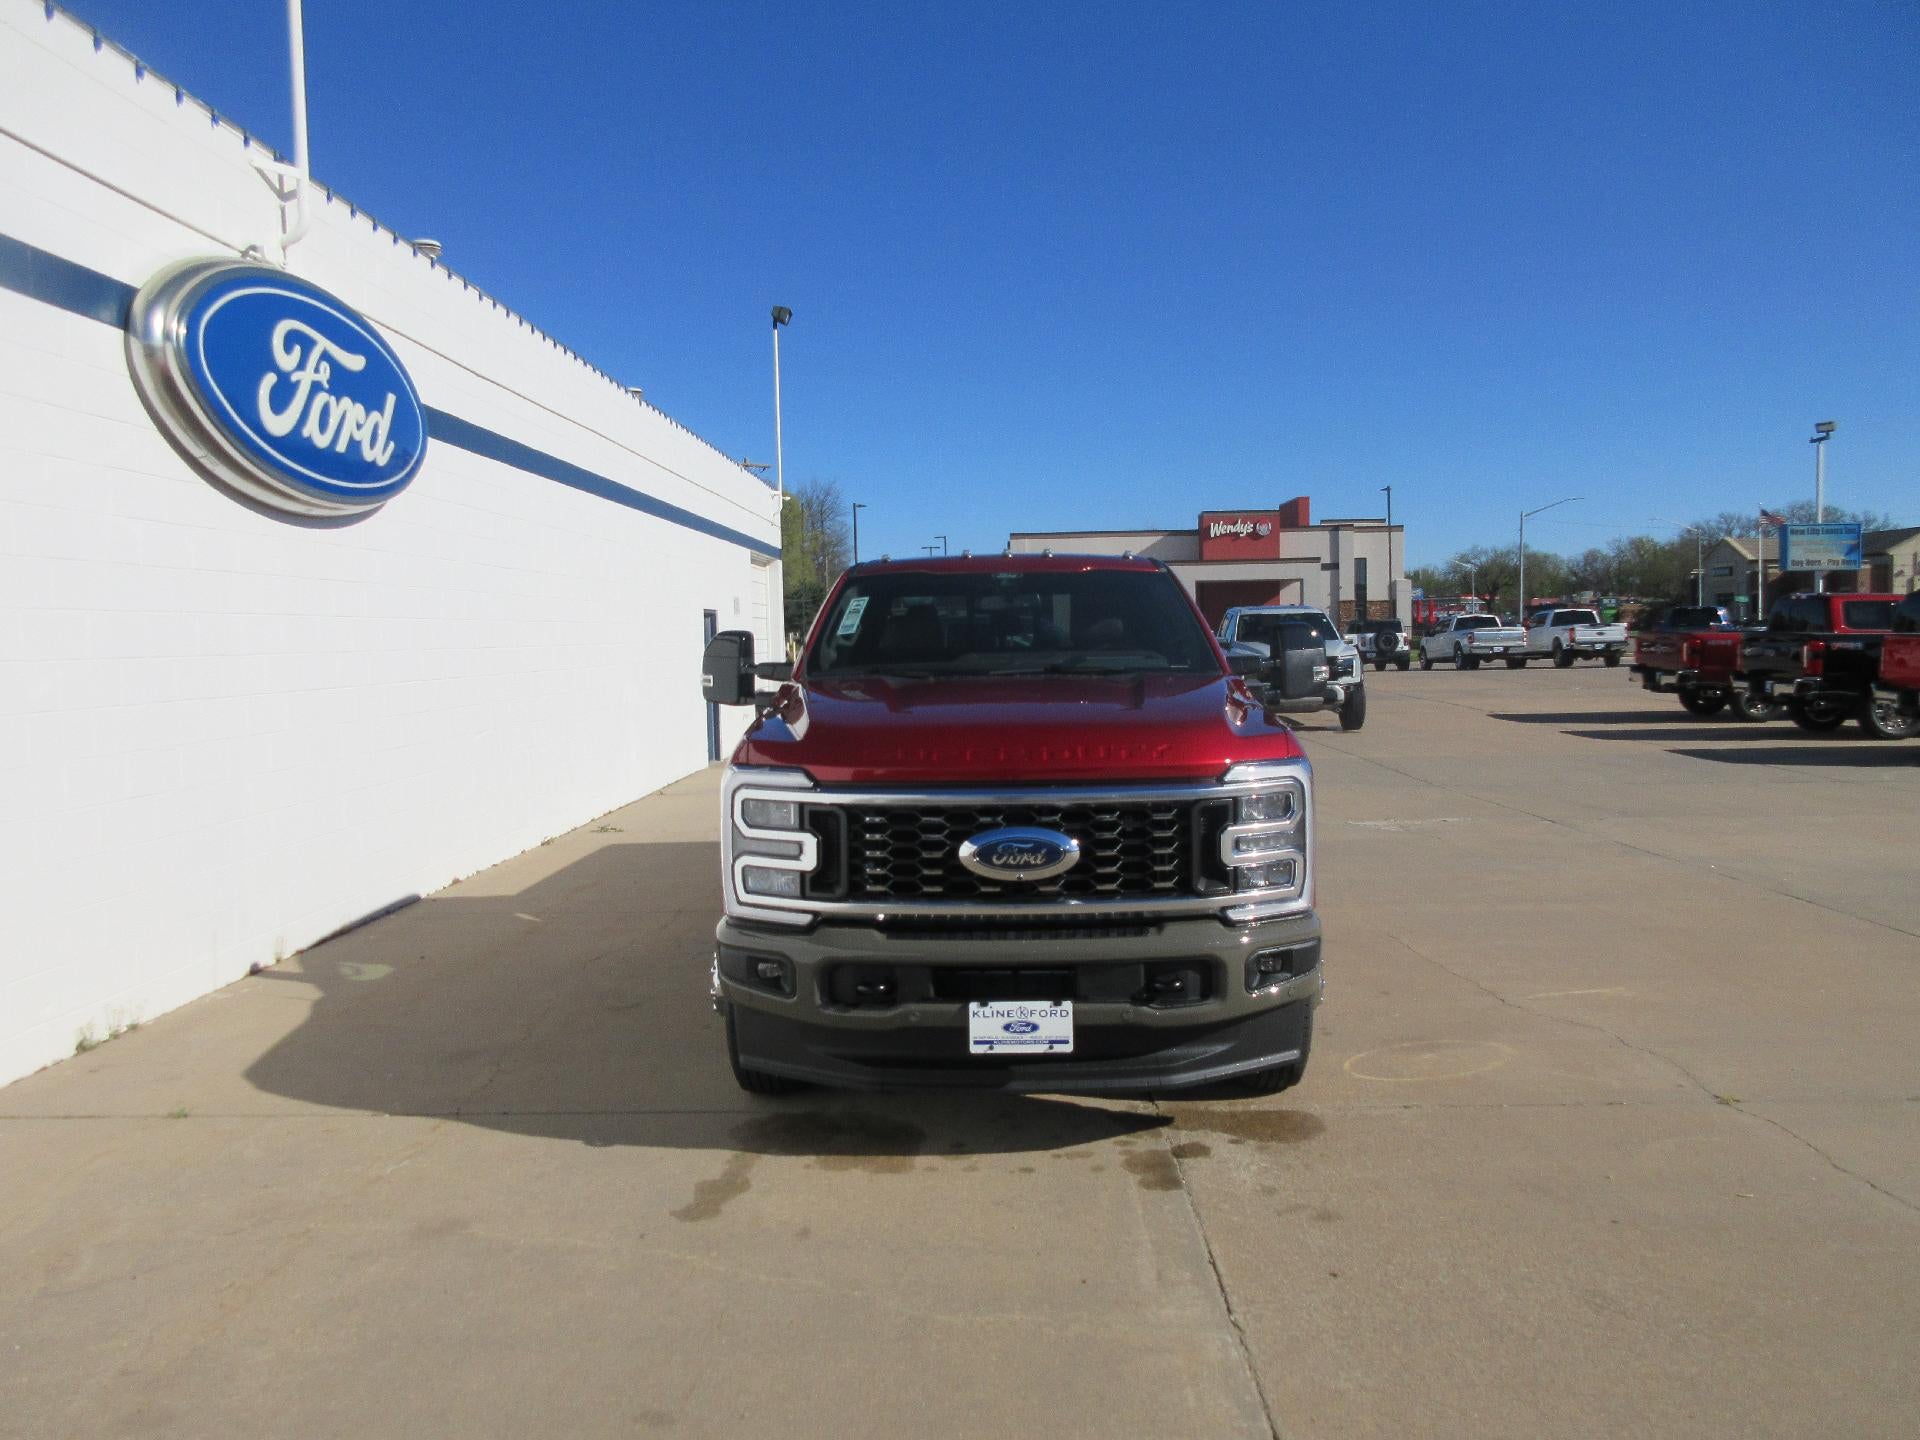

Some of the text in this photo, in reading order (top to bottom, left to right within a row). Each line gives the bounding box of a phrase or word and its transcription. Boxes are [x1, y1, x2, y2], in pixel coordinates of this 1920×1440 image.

[257, 318, 397, 467] Ford
[1210, 519, 1254, 538] Wendy's
[991, 841, 1048, 866] Ford
[972, 1009, 1014, 1018] KLINE
[1029, 1008, 1069, 1018] FORD
[1009, 1022, 1032, 1032] Ford
